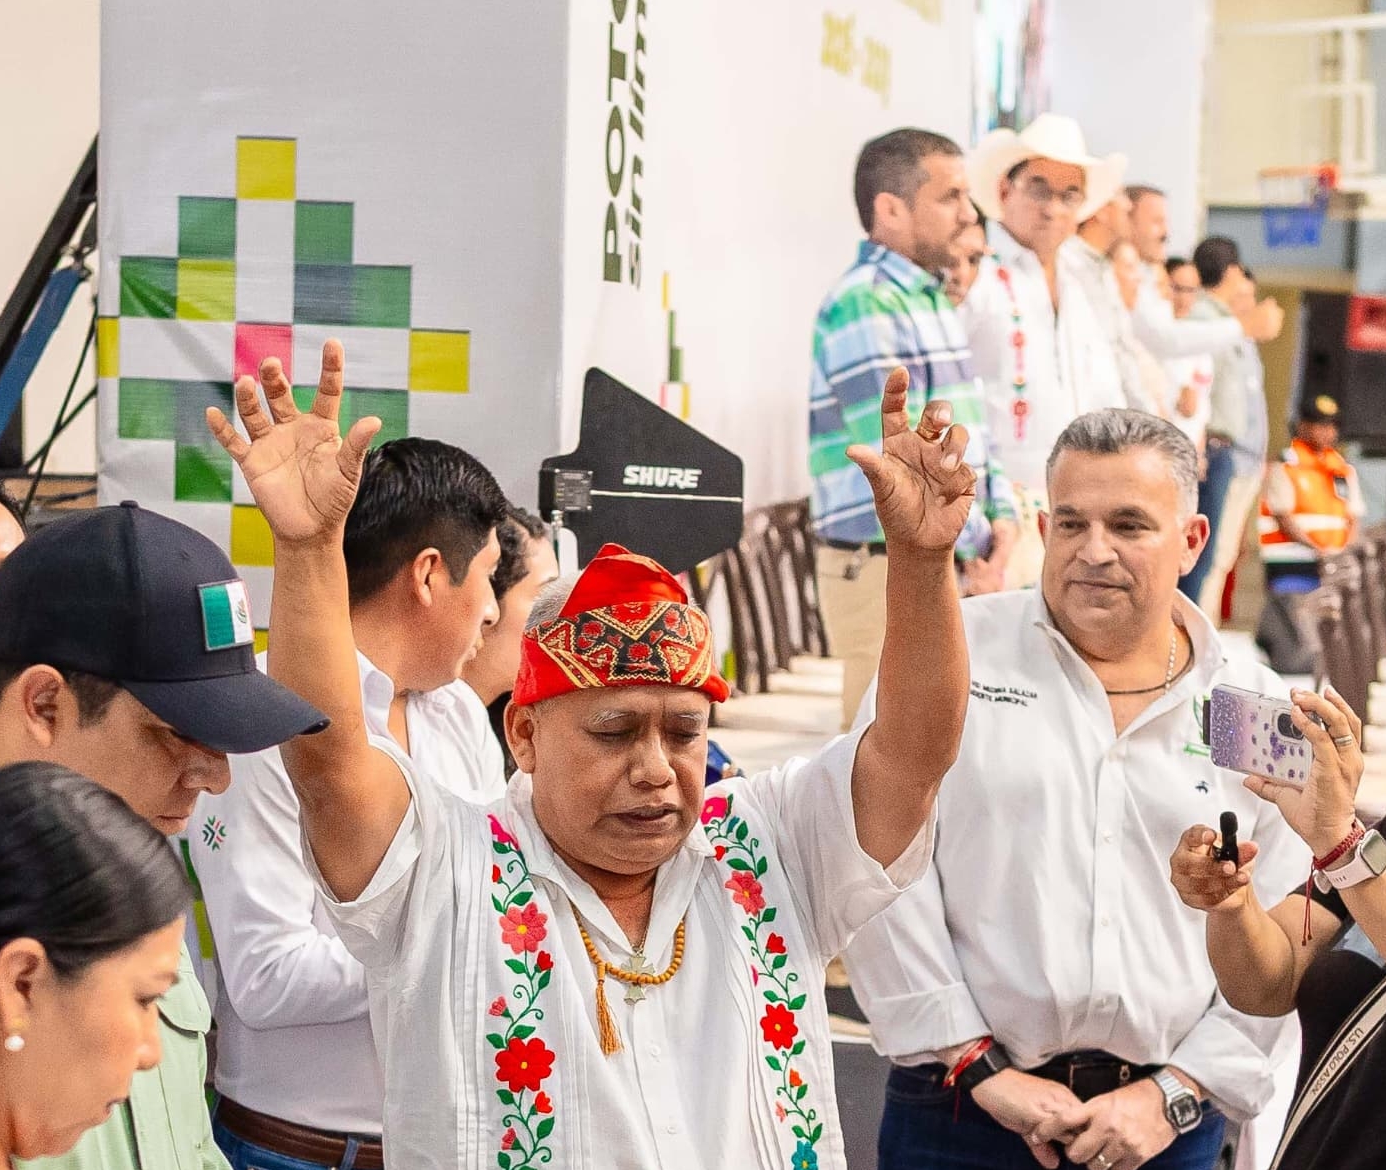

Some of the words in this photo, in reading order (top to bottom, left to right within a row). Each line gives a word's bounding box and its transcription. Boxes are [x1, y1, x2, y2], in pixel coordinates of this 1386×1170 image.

[628, 0, 647, 141] lím
[603, 0, 627, 283] POT
[625, 153, 643, 291] sin
[622, 464, 703, 489] SHURE
[1328, 1044, 1350, 1071] POLO
[1345, 1027, 1365, 1046] U.S.
